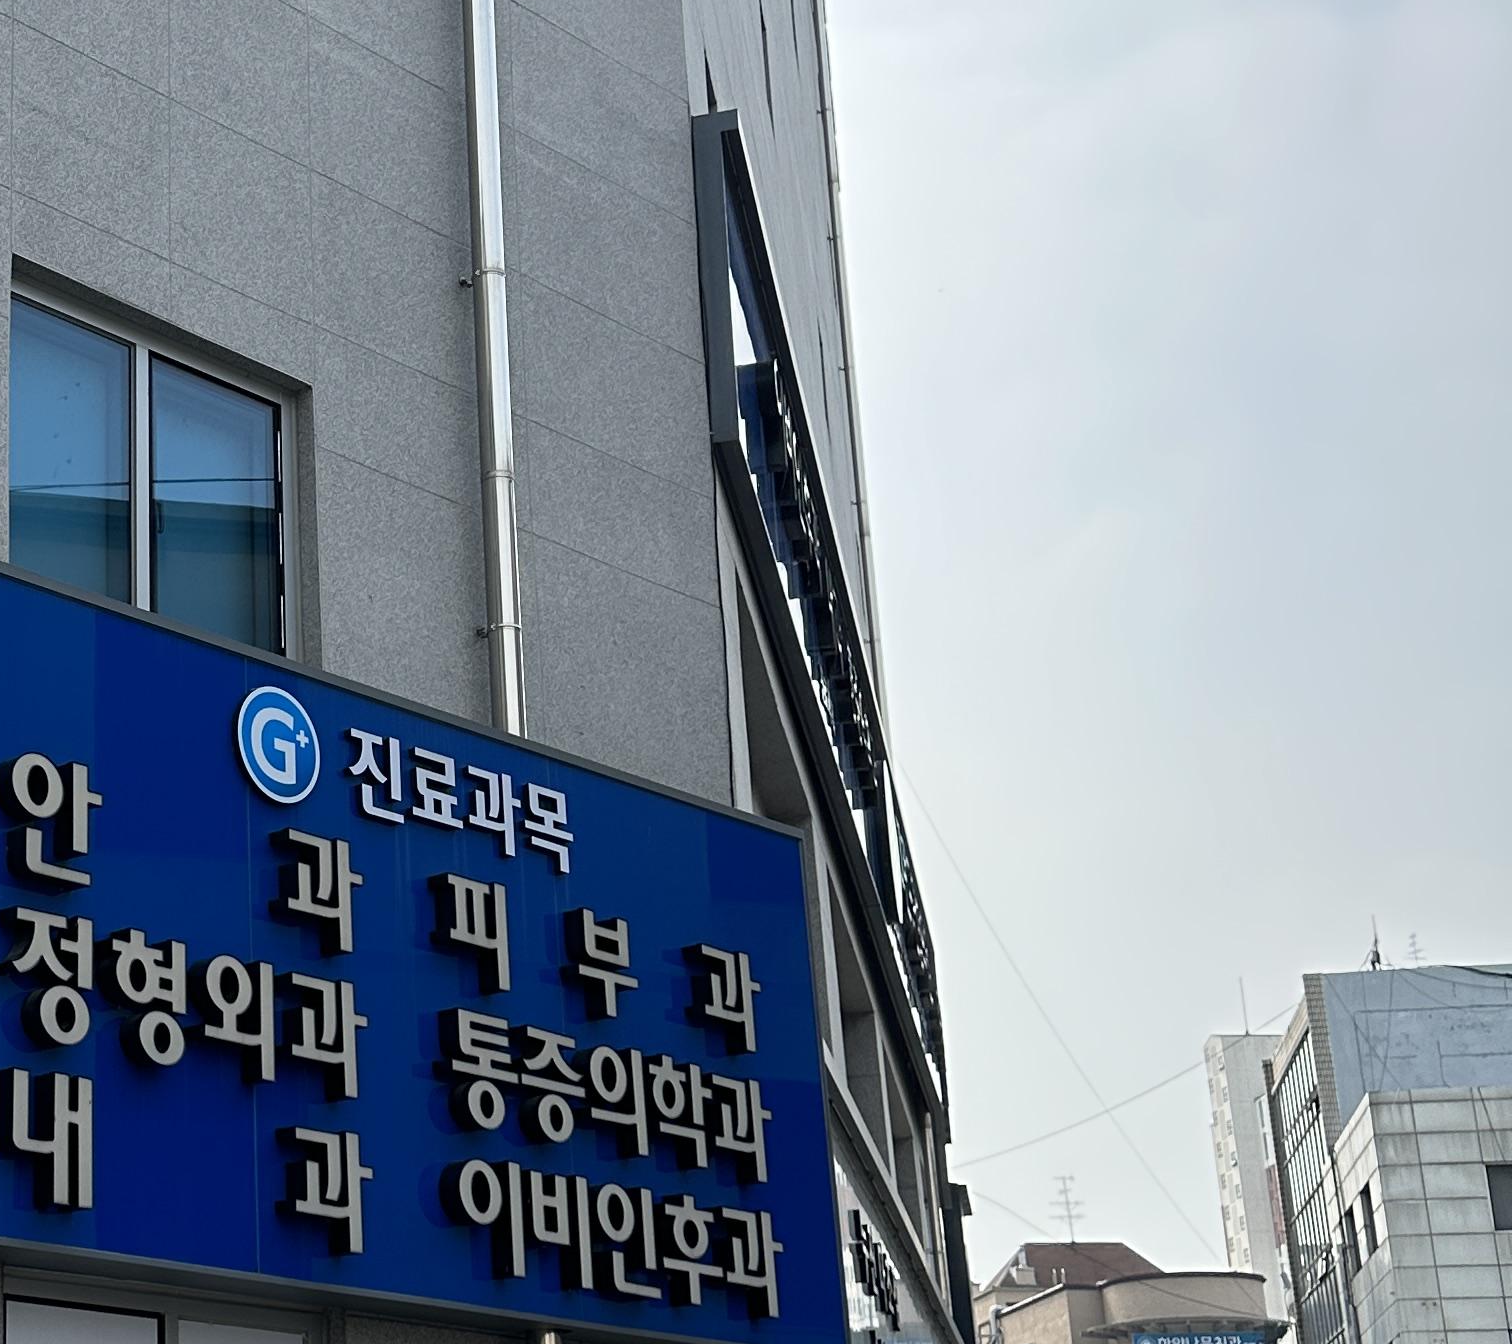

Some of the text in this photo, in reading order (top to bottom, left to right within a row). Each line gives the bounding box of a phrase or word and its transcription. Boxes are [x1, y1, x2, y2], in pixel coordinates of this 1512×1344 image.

[348, 727, 575, 875] 진료과목
[12, 907, 369, 1099] 정형외과
[451, 1007, 773, 1183] 통증의학과
[458, 1158, 785, 1318] 이비인후과
